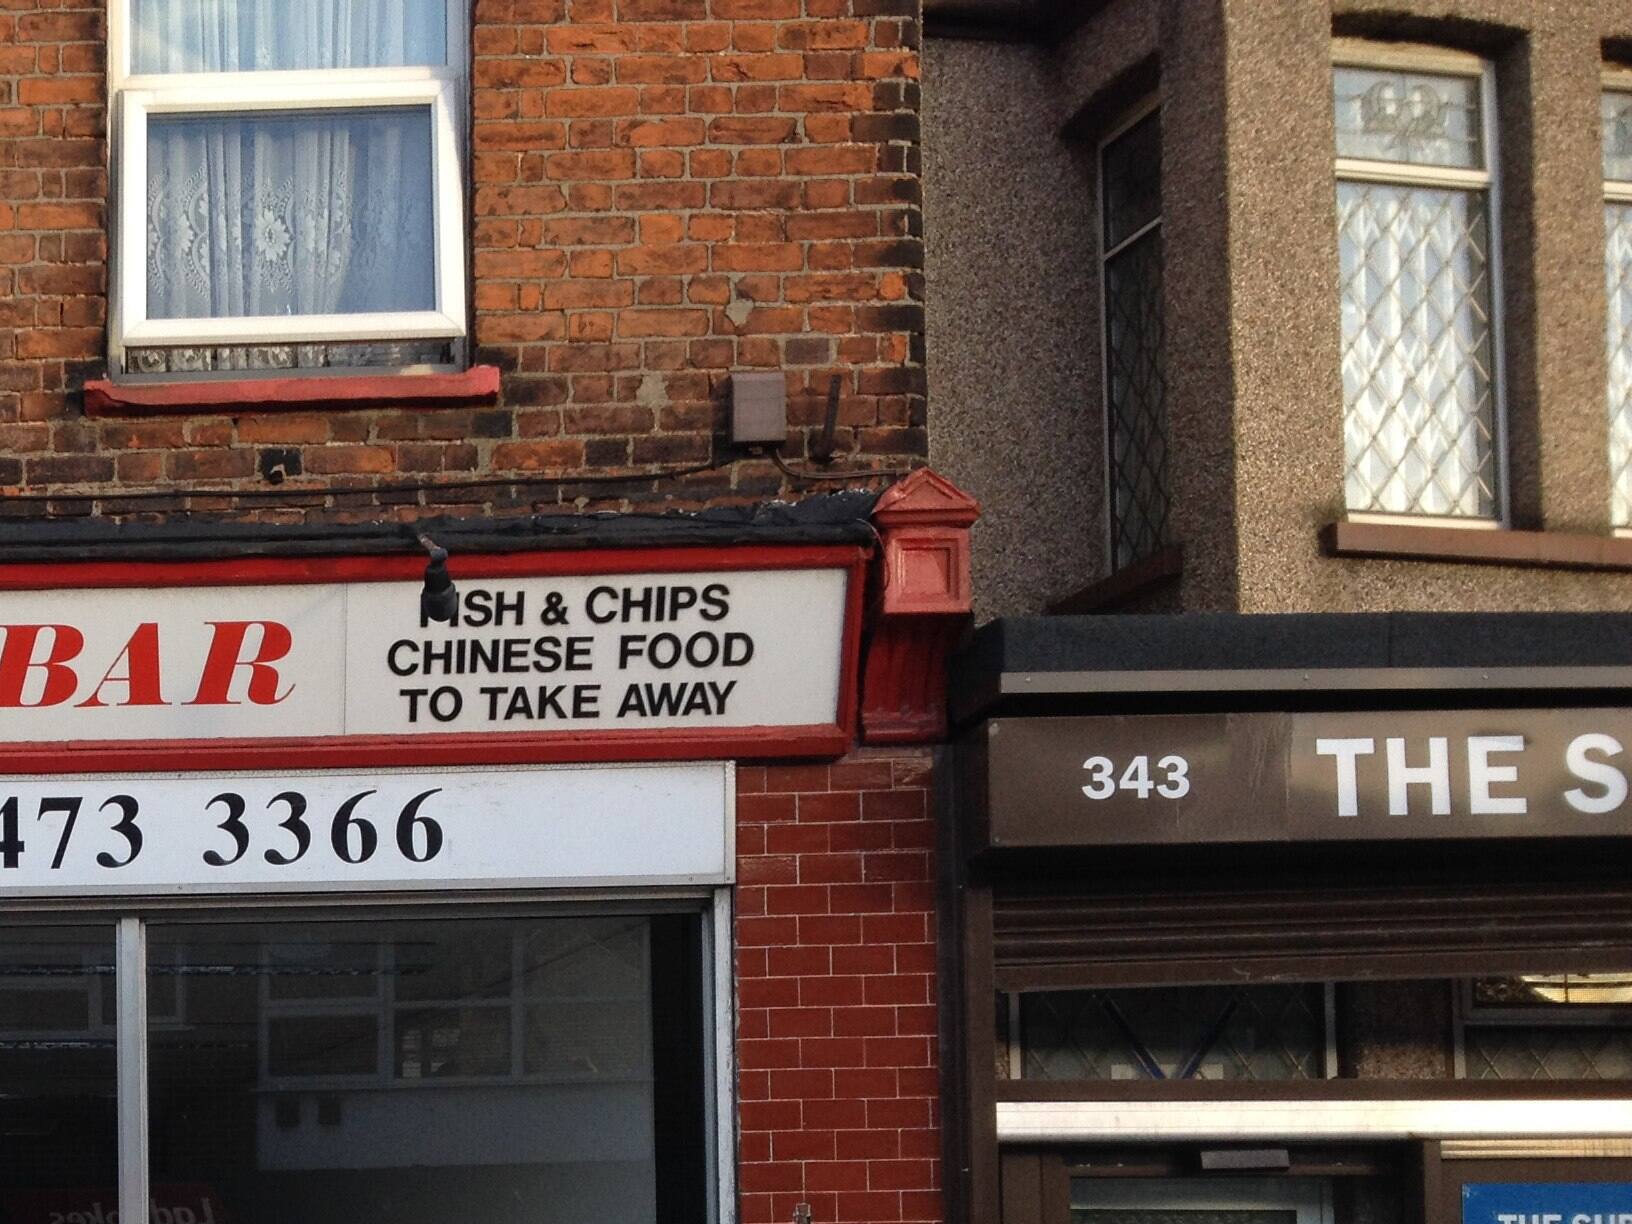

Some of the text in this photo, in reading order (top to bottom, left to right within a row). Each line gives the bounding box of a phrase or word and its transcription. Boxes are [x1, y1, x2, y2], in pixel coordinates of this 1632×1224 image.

[541, 591, 569, 627] &
[584, 583, 731, 624] CHIPS
[387, 630, 755, 677] CHINESE FOOD
[399, 680, 738, 723] TO TAKE AWAY
[1080, 754, 1190, 800] 343
[1315, 734, 1528, 818] THE
[201, 787, 444, 868] 3366
